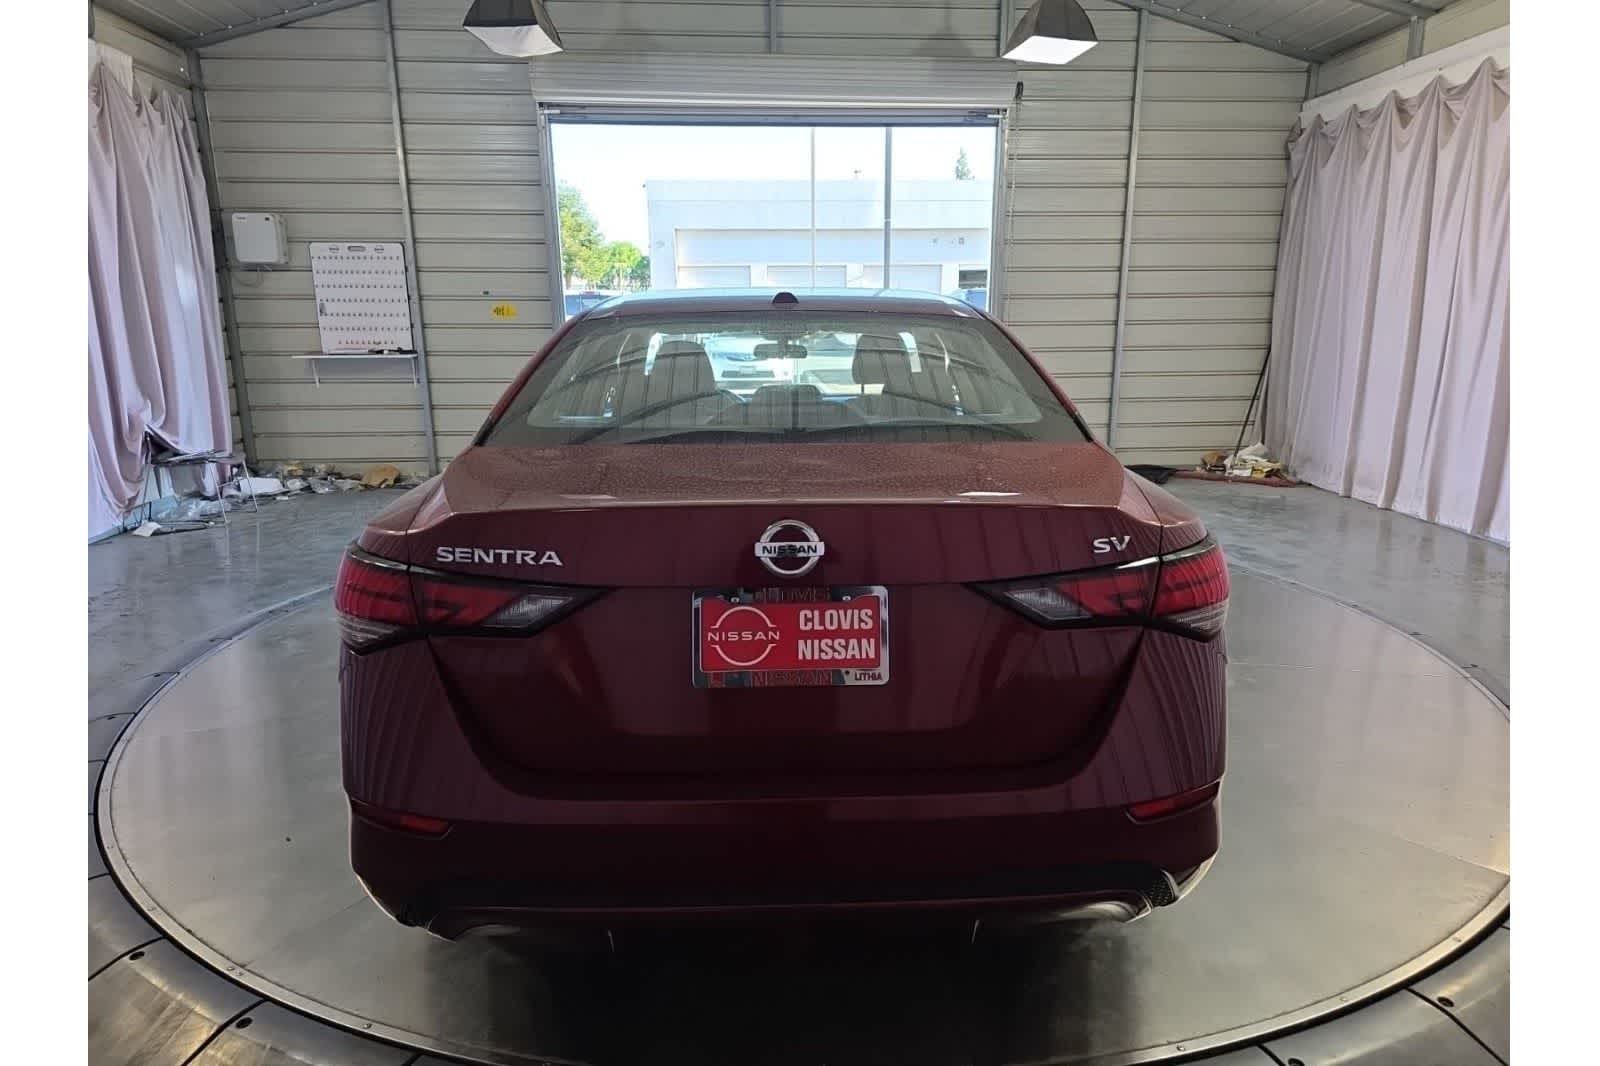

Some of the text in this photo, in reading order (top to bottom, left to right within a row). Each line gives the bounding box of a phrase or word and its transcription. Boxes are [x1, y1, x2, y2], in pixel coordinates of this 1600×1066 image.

[761, 544, 818, 554] NISSAN
[1093, 535, 1131, 553] SV
[436, 546, 563, 566] SENTRA
[799, 608, 873, 631] CLOVIS
[707, 631, 780, 641] NISSAN
[797, 637, 875, 660] NISSAN
[854, 671, 883, 681] LITHIA
